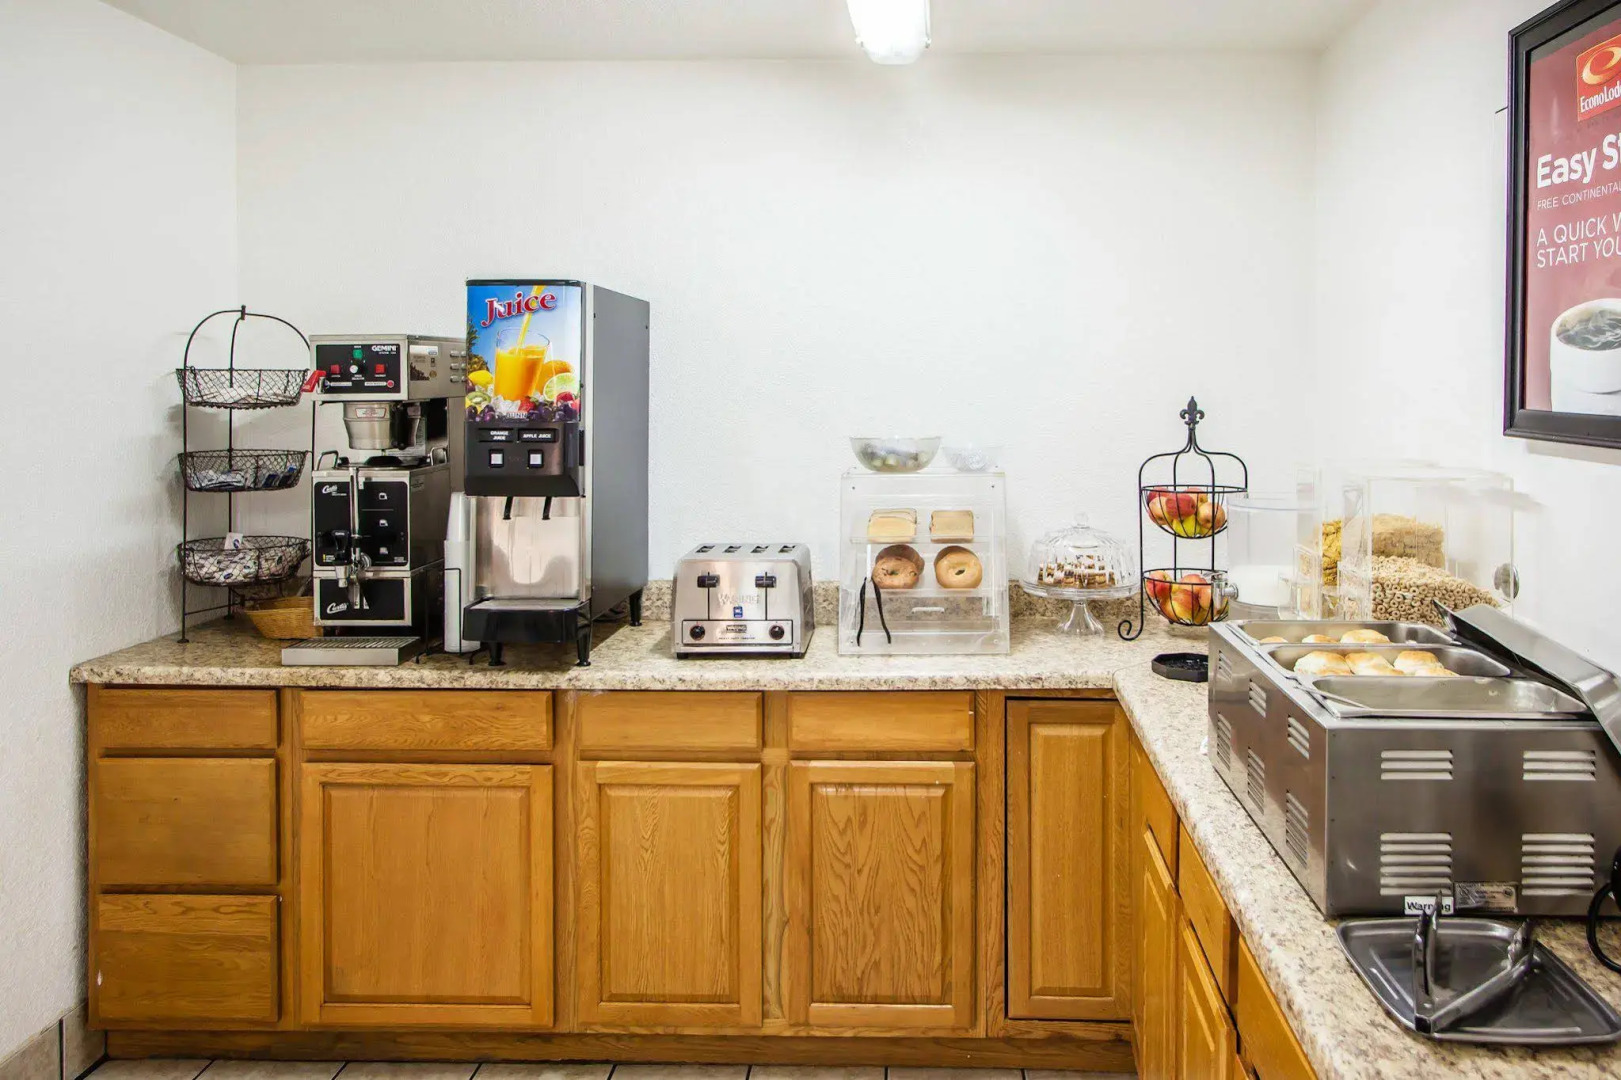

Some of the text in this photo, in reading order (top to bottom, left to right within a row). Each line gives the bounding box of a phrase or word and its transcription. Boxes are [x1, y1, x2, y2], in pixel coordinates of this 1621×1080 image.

[1580, 80, 1621, 113] EconoLod
[1537, 148, 1597, 188] Easy
[1537, 197, 1559, 210] FREE
[1537, 228, 1548, 247] A
[1554, 215, 1607, 244] QUICK
[1537, 242, 1588, 268] START
[481, 291, 557, 328] Juice
[1407, 901, 1451, 912] Warng
